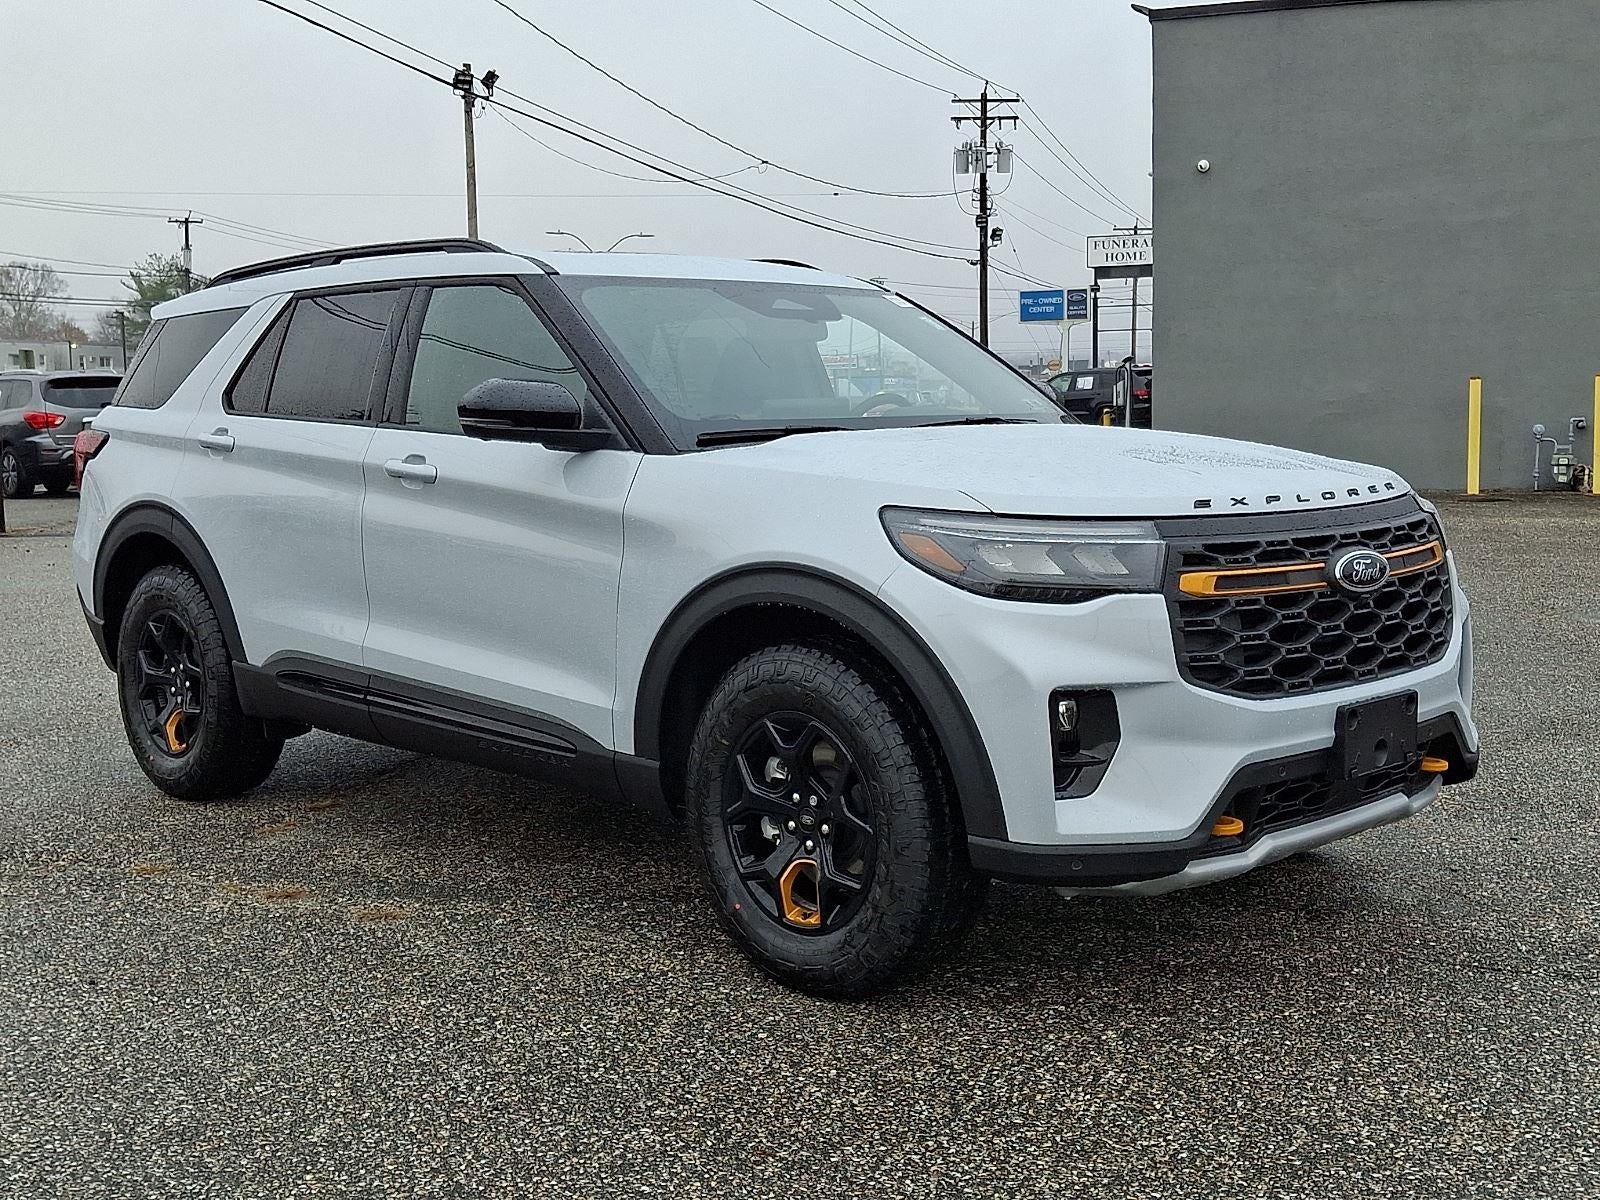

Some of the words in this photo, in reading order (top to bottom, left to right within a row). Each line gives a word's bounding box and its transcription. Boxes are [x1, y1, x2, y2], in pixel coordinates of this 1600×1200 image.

[1105, 251, 1146, 262] HOME
[1193, 481, 1396, 509] EXPLORER
[1352, 559, 1380, 581] Ford
